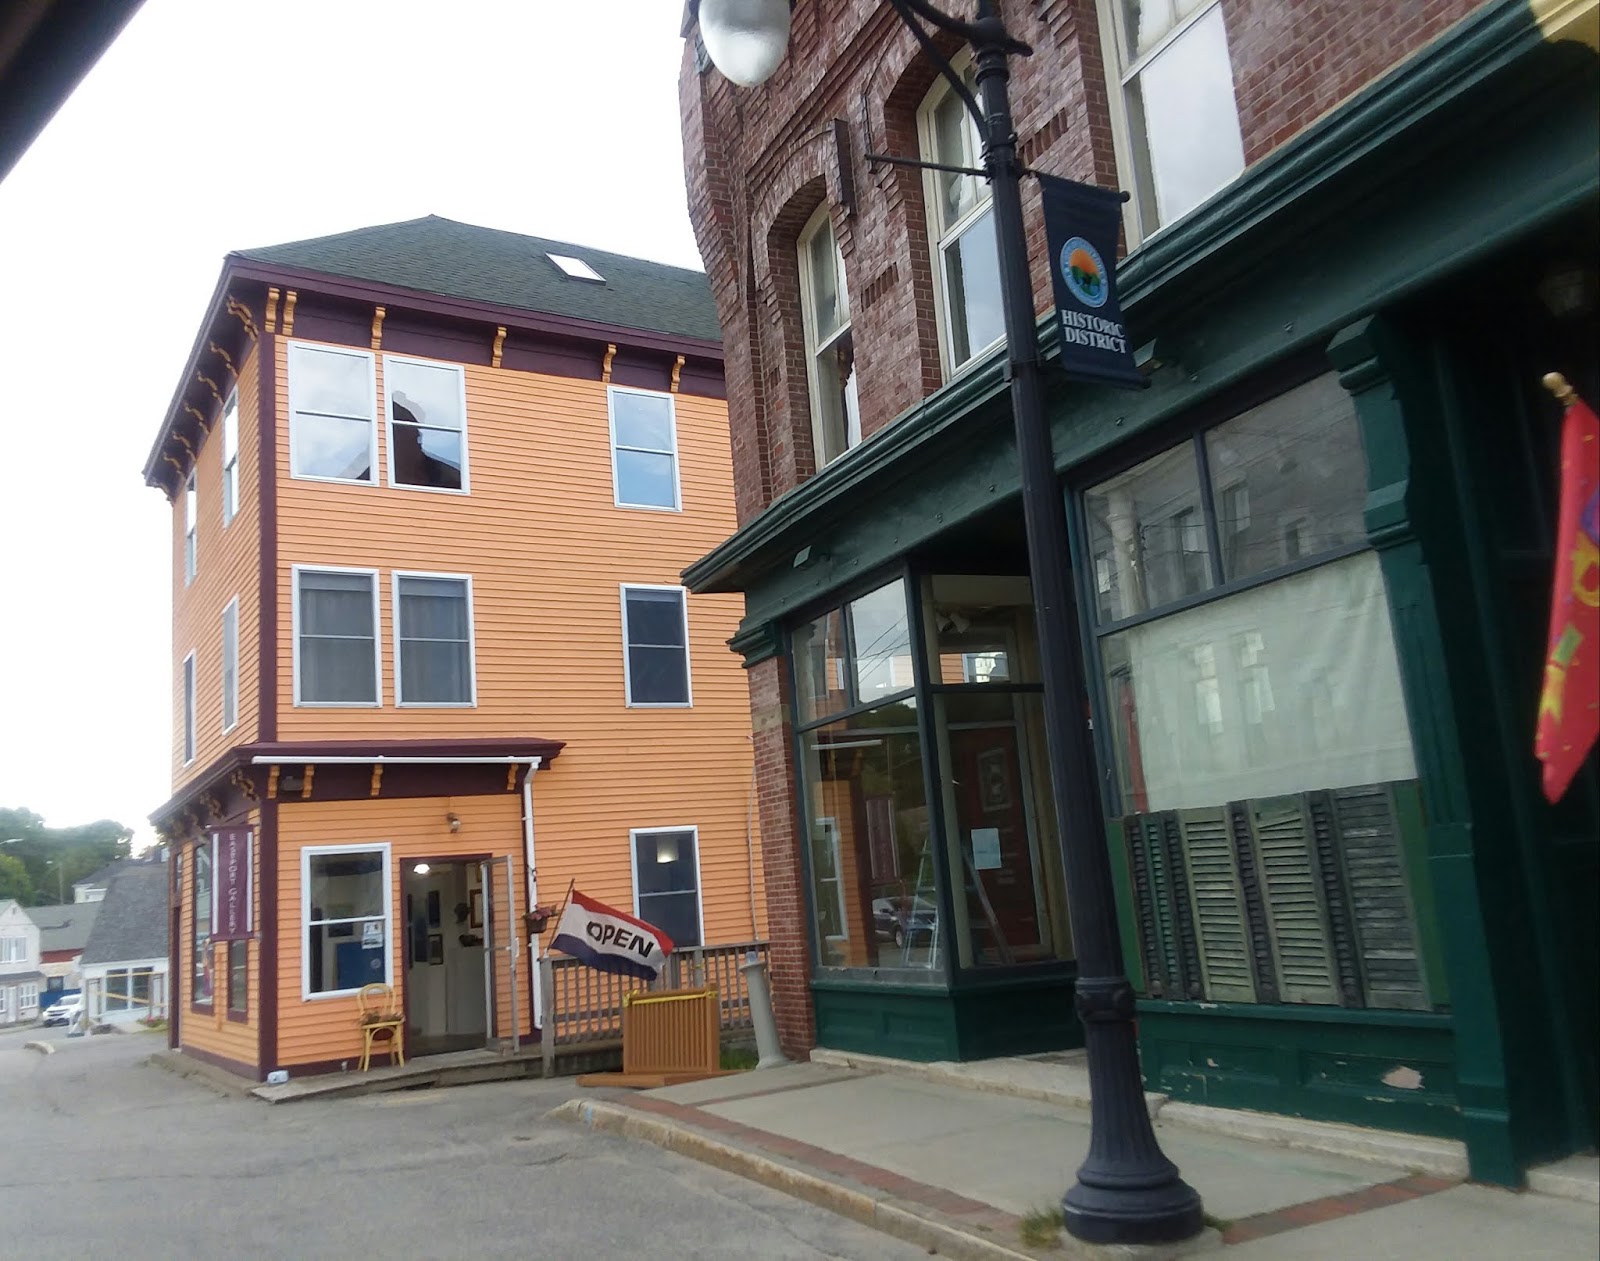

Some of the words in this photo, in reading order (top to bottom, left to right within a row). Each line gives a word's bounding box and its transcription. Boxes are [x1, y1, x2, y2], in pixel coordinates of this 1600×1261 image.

[1061, 309, 1125, 338] HISTORIC
[1064, 327, 1127, 354] DISTRICT
[586, 921, 654, 958] OPEN
